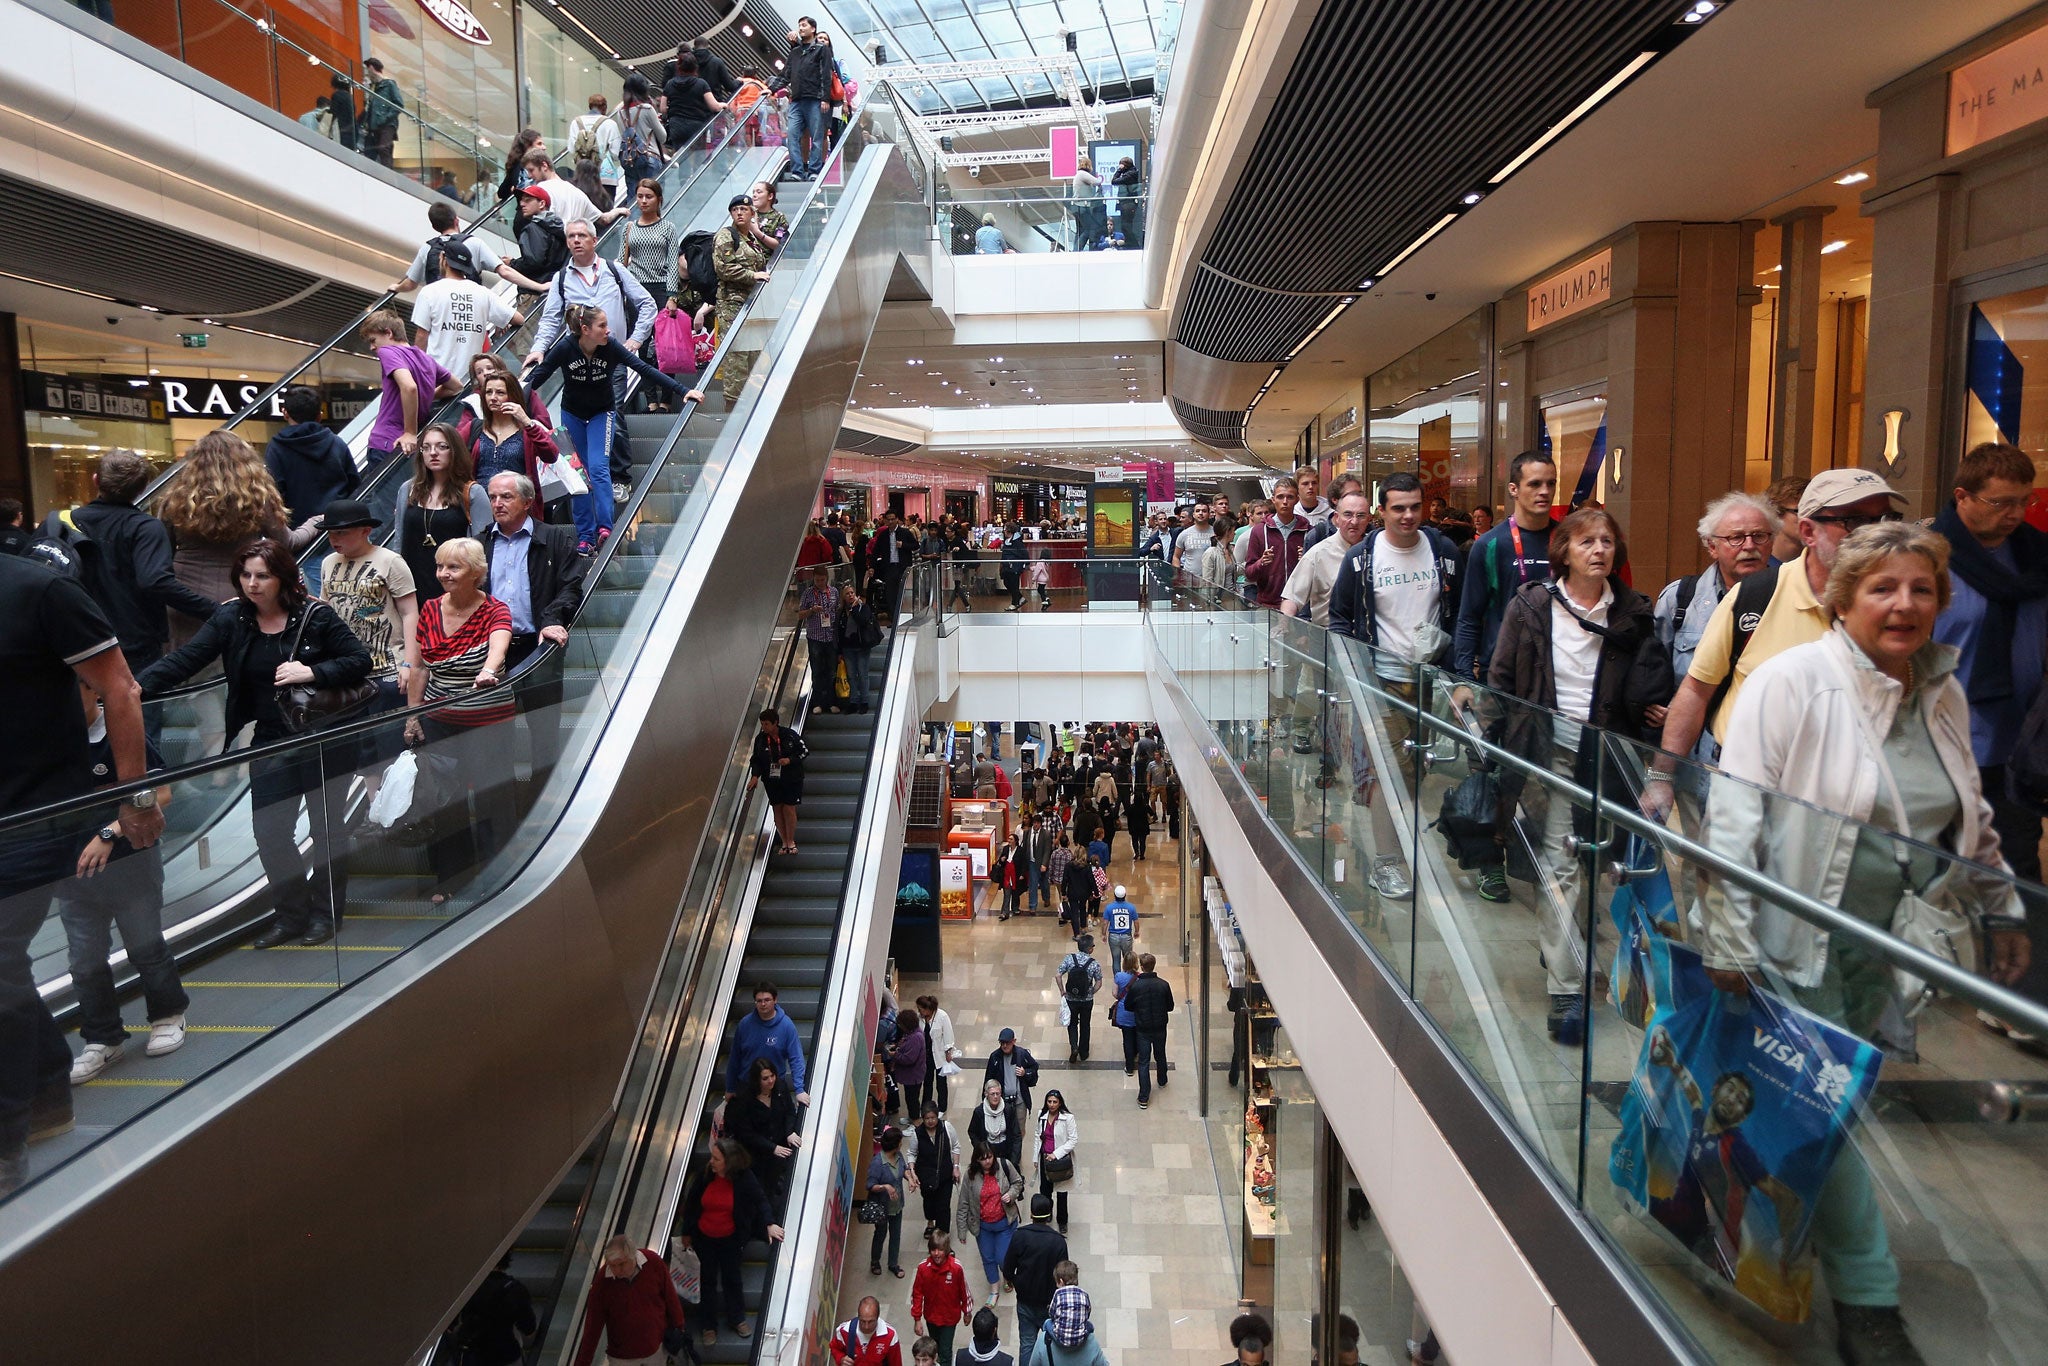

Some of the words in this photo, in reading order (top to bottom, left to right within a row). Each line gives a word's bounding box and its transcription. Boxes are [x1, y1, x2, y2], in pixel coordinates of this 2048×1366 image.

[1959, 88, 1996, 117] THE
[450, 292, 473, 302] ONE
[1530, 261, 1610, 321] TRIUMPH
[451, 303, 473, 311] FOR
[452, 312, 473, 321] THE
[441, 322, 482, 333] ANGELS
[994, 482, 1019, 494] MONSOON
[1378, 568, 1437, 587] IRELAND
[1118, 916, 1126, 927] 8
[1753, 1025, 1805, 1072] VISA
[1793, 1090, 1832, 1115] SPONSOR
